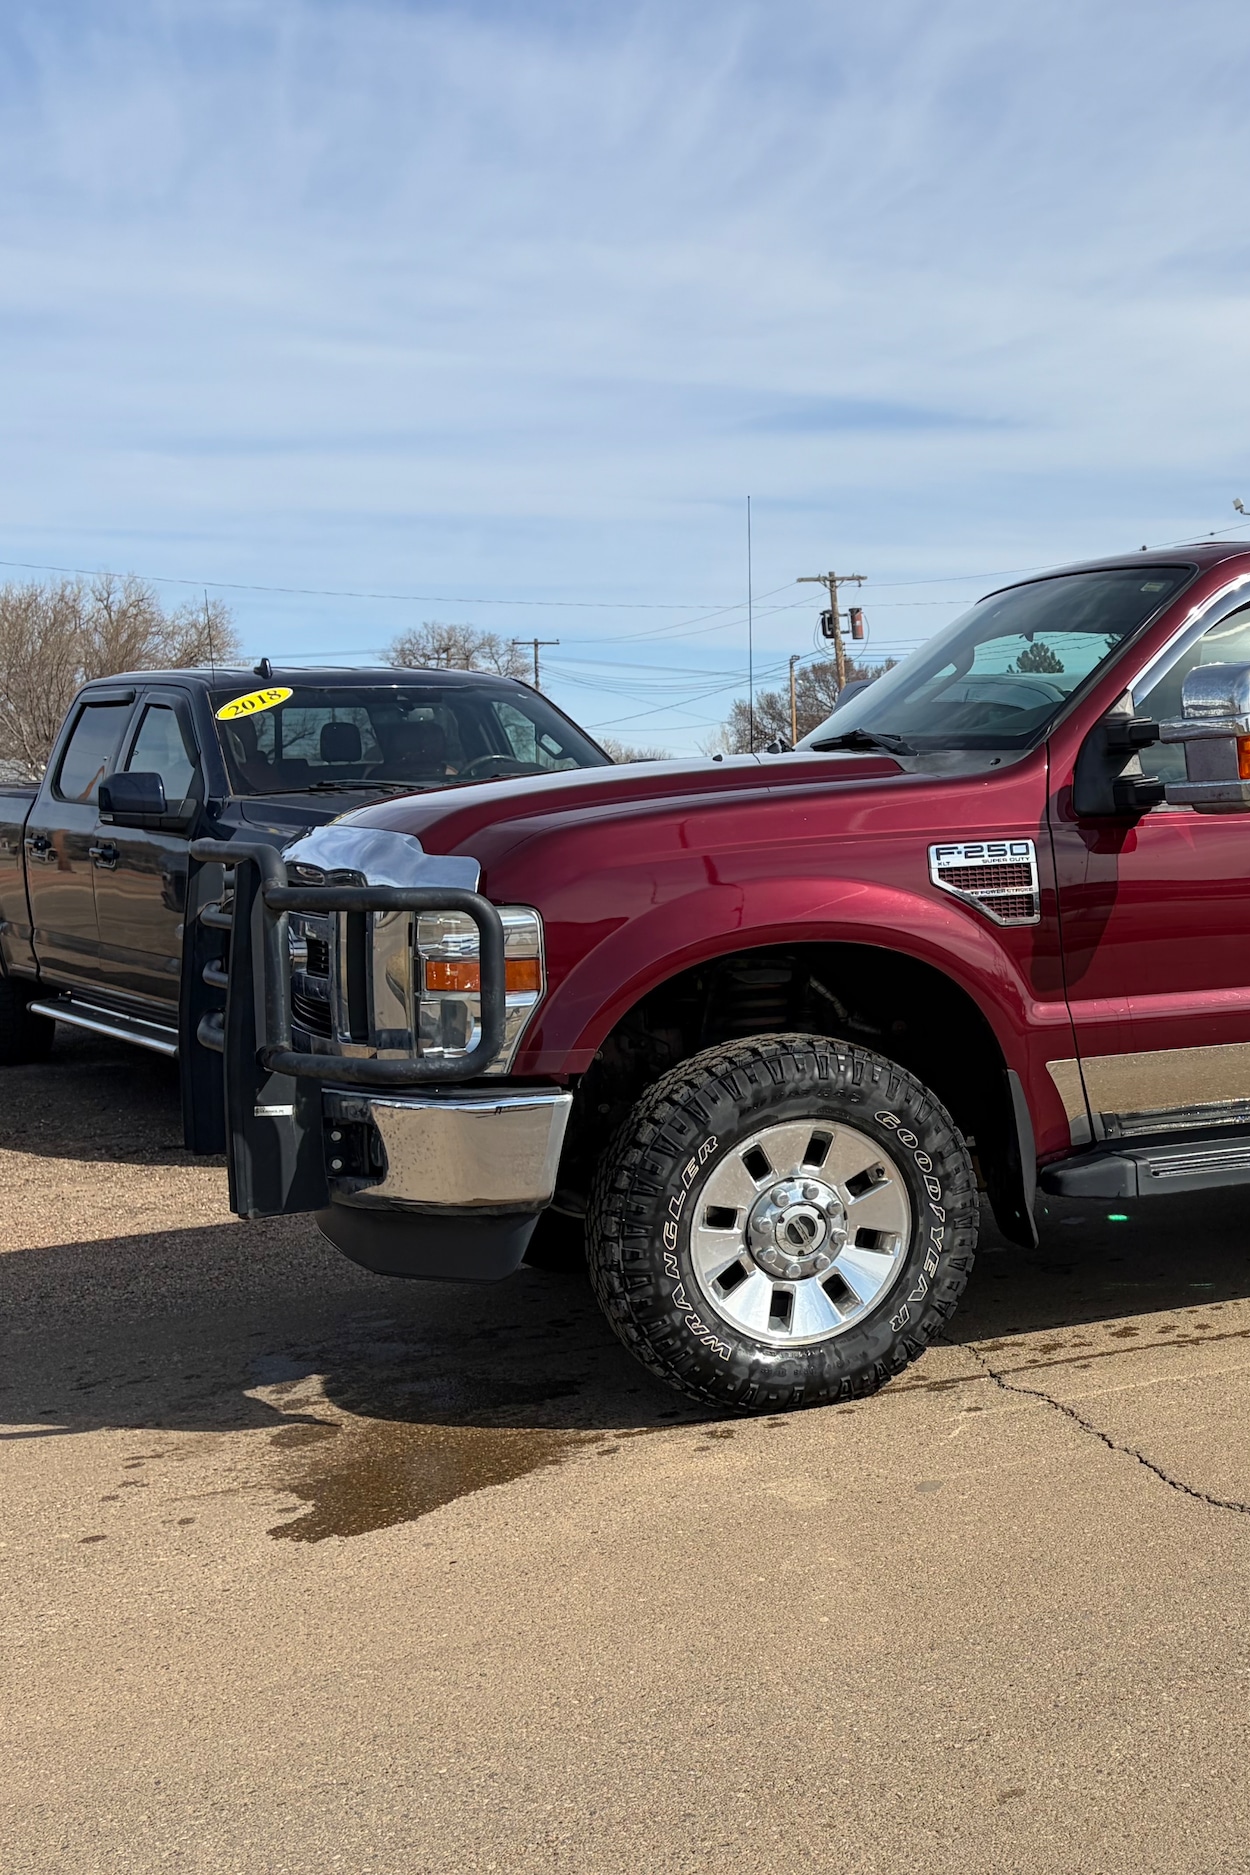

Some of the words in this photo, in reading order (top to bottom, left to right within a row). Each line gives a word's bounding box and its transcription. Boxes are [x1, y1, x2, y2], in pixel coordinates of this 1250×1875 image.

[227, 690, 282, 716] 2018
[935, 842, 1030, 861] F-250
[662, 1135, 732, 1361] WRANGLER
[874, 1110, 946, 1332] GOODYEAR
